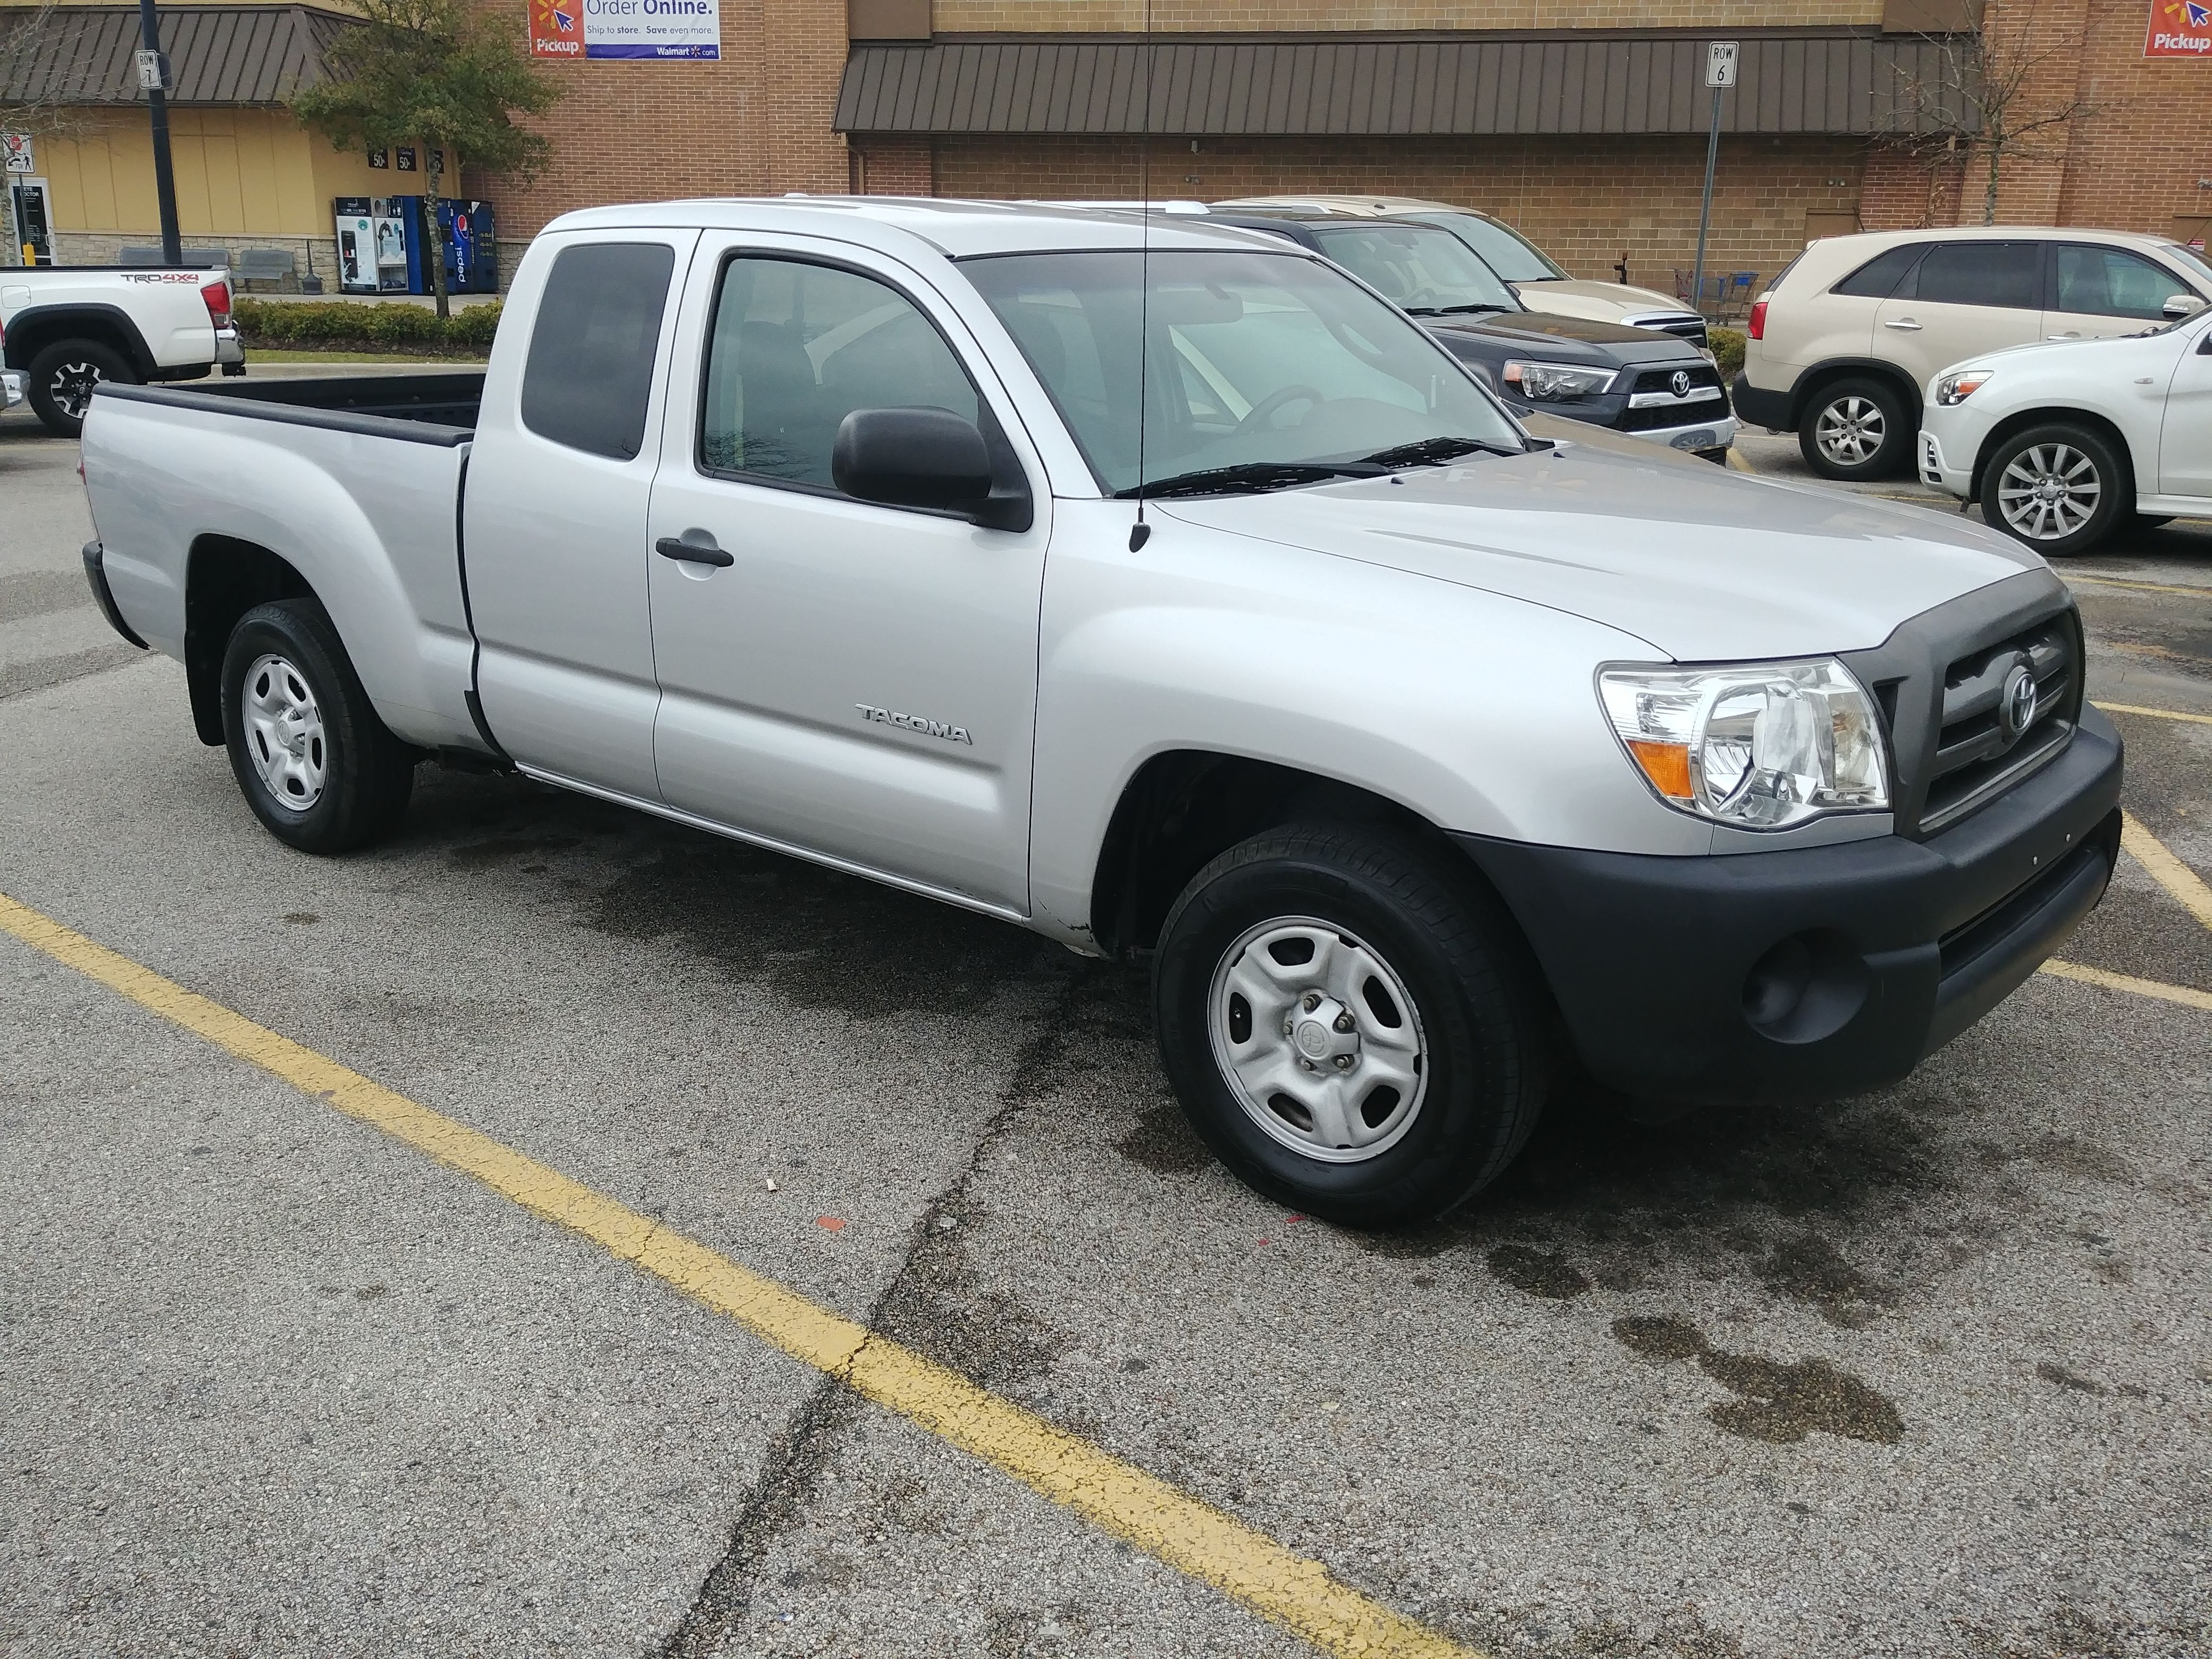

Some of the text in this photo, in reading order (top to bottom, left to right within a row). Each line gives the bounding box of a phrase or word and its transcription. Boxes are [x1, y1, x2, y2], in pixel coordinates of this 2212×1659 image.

[586, 0, 713, 14] Order Online.
[587, 25, 605, 36] Ship
[537, 38, 579, 55] Pickup
[2154, 33, 2211, 53] Pickup
[657, 47, 689, 55] Walmart
[1713, 47, 1733, 60] ROW
[140, 55, 154, 65] ROW
[146, 69, 151, 82] 7
[1717, 65, 1725, 81] 6
[455, 246, 466, 283] pepsi
[854, 703, 973, 745] TACOMA
